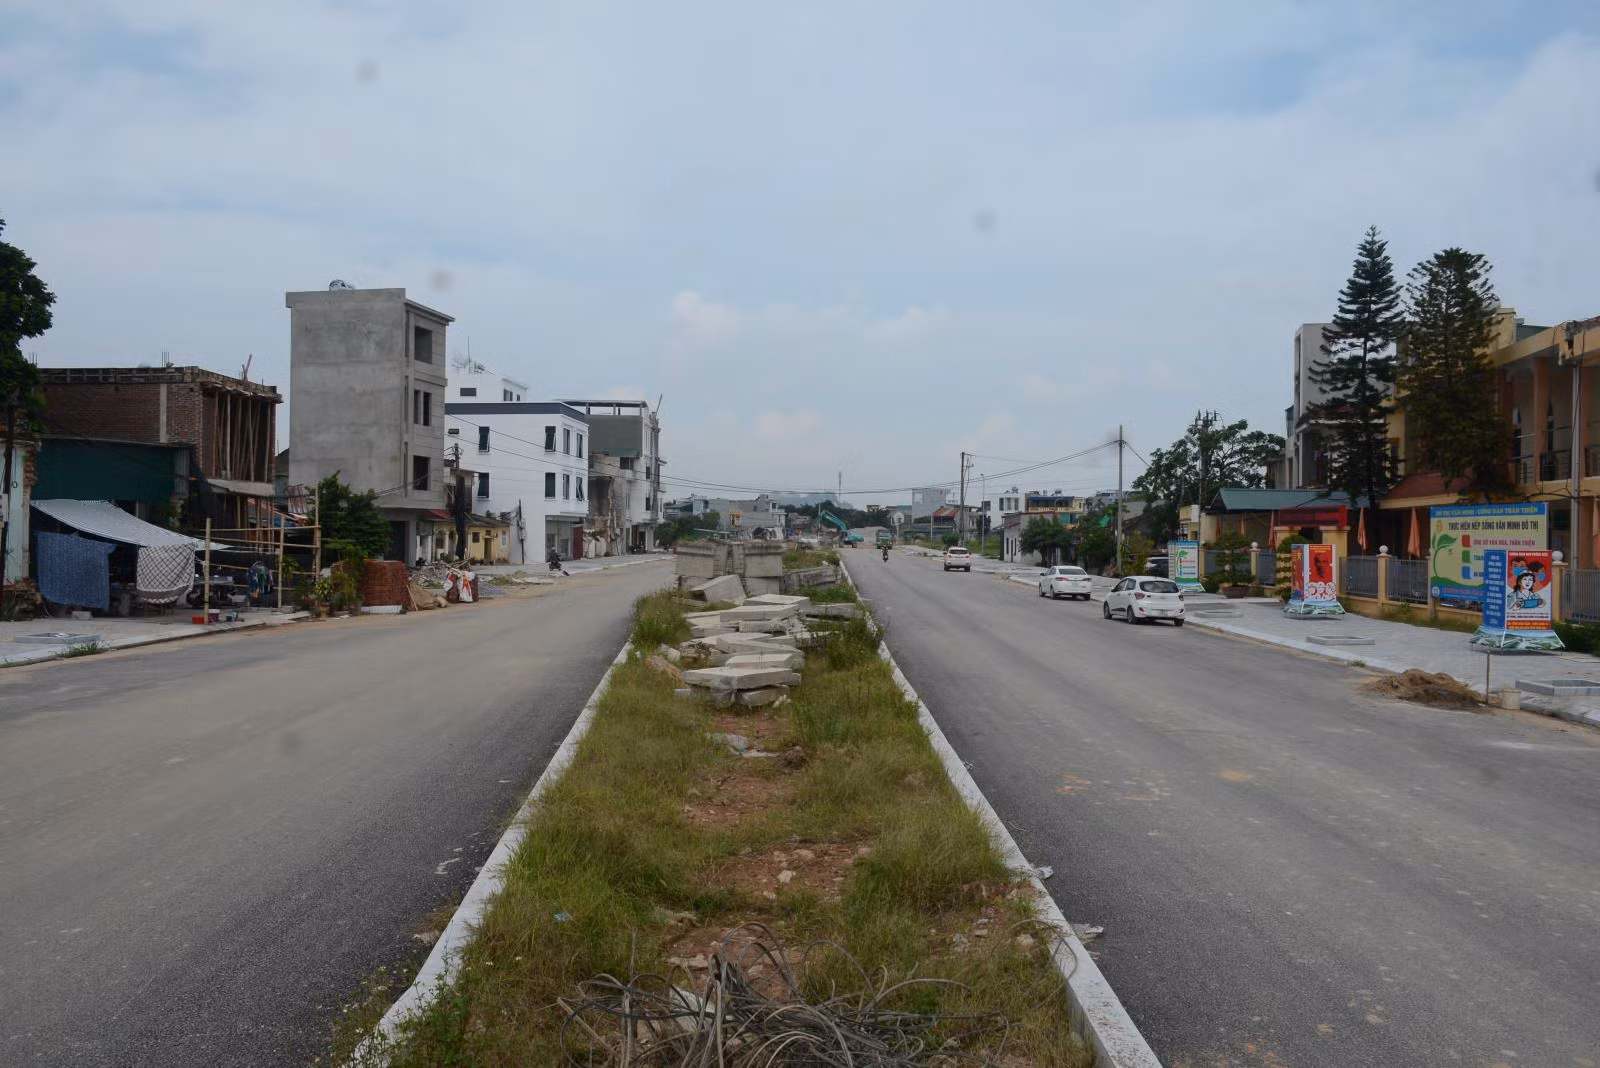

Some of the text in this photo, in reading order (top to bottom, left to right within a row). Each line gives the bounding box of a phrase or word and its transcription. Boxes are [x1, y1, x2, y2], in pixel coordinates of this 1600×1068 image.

[1449, 519, 1538, 532] THỰC HIỆN NẾP SỐNG VĂN MINH ĐÔ THỊ
